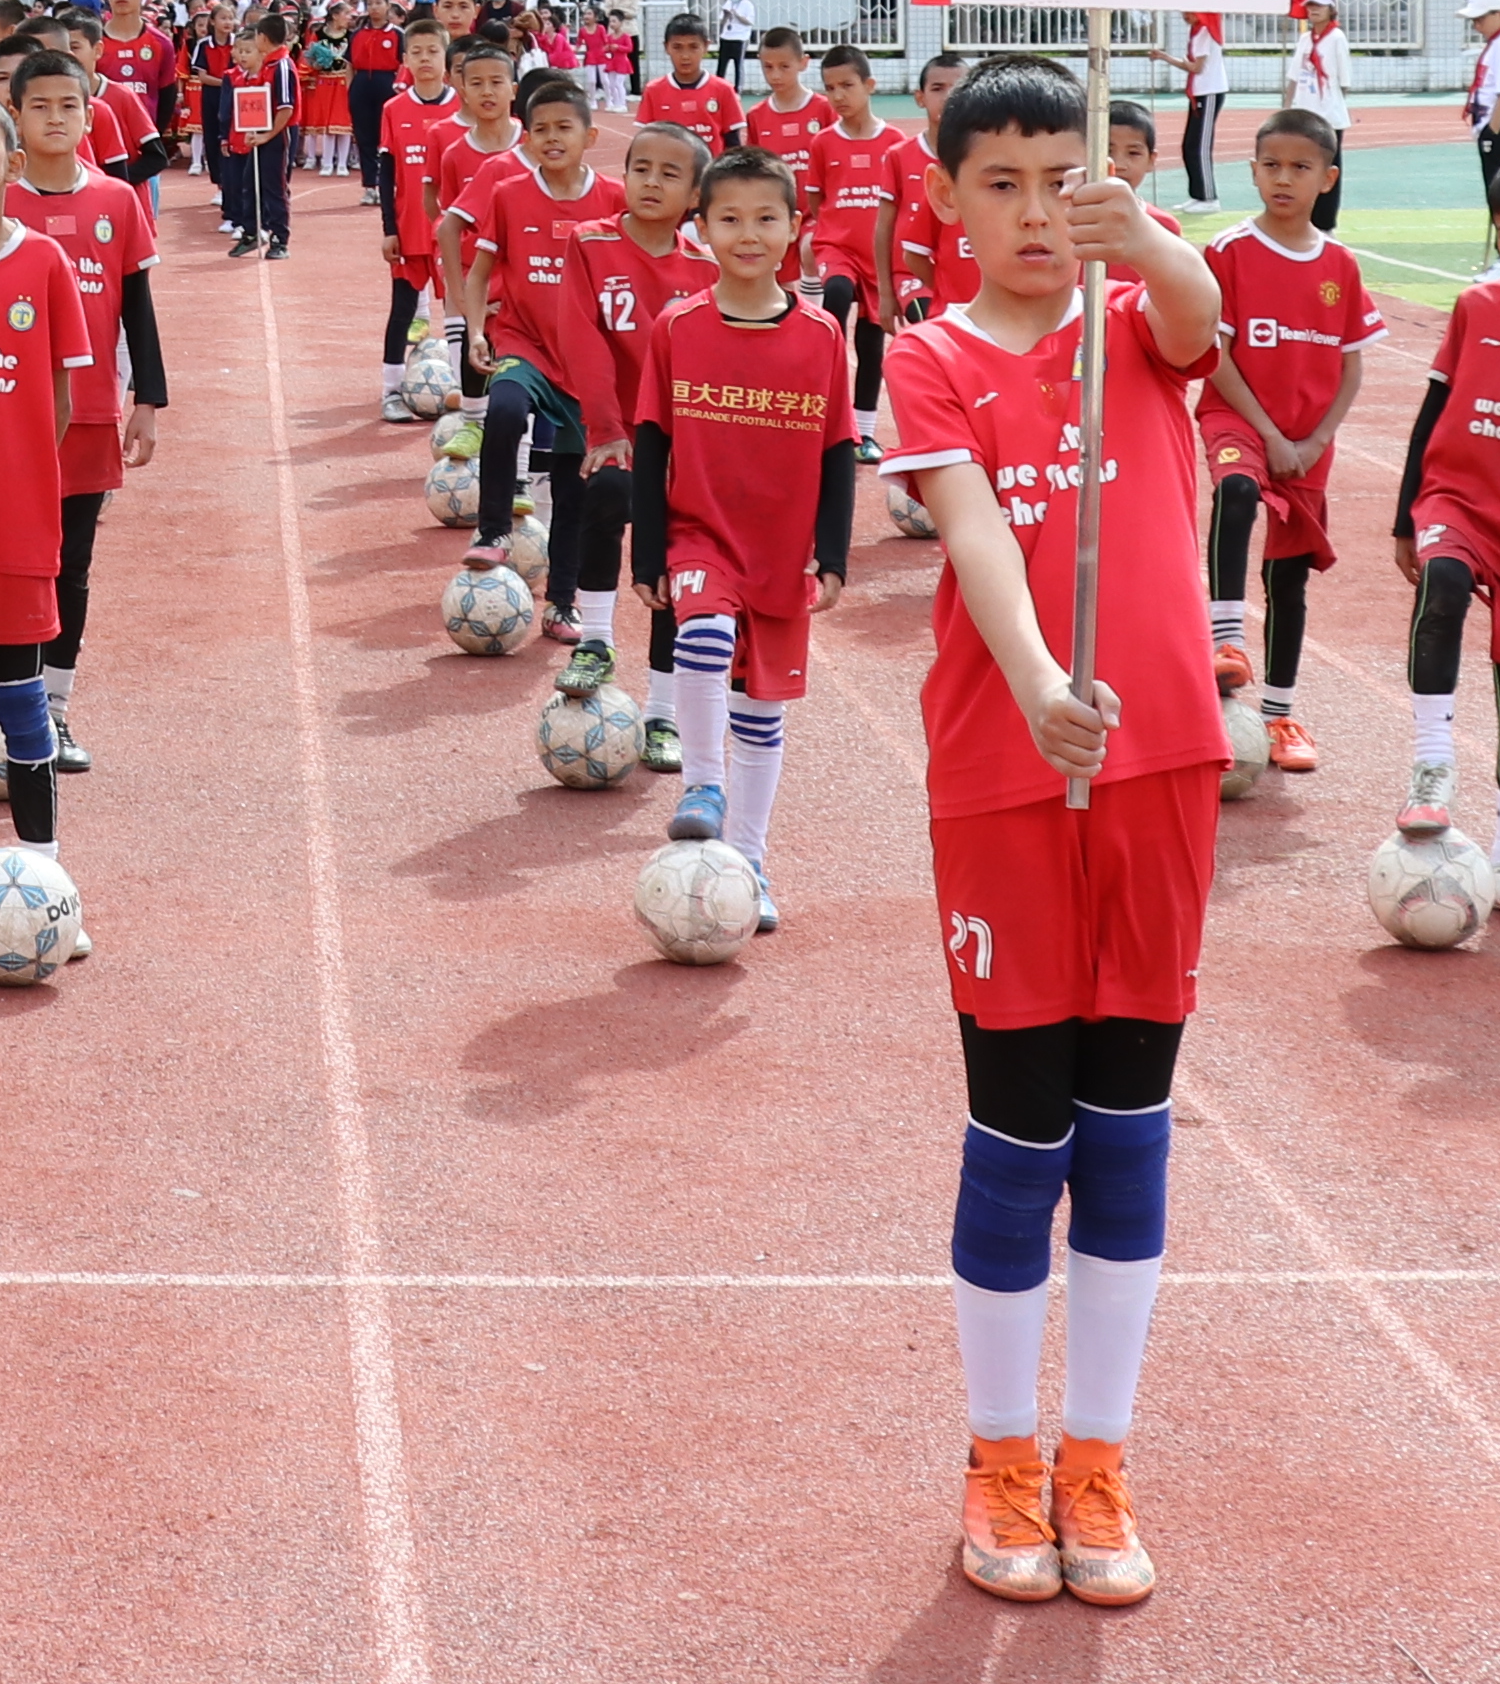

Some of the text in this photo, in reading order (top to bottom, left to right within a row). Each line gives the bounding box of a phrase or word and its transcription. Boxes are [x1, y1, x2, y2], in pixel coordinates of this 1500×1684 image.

[798, 150, 810, 160] th
[851, 185, 871, 196] are
[835, 196, 881, 209] champio
[79, 257, 104, 275] the
[528, 255, 552, 268] we
[599, 290, 637, 332] 12
[1277, 325, 1342, 347] TeamViewer
[732, 414, 784, 430] FOOTBALL
